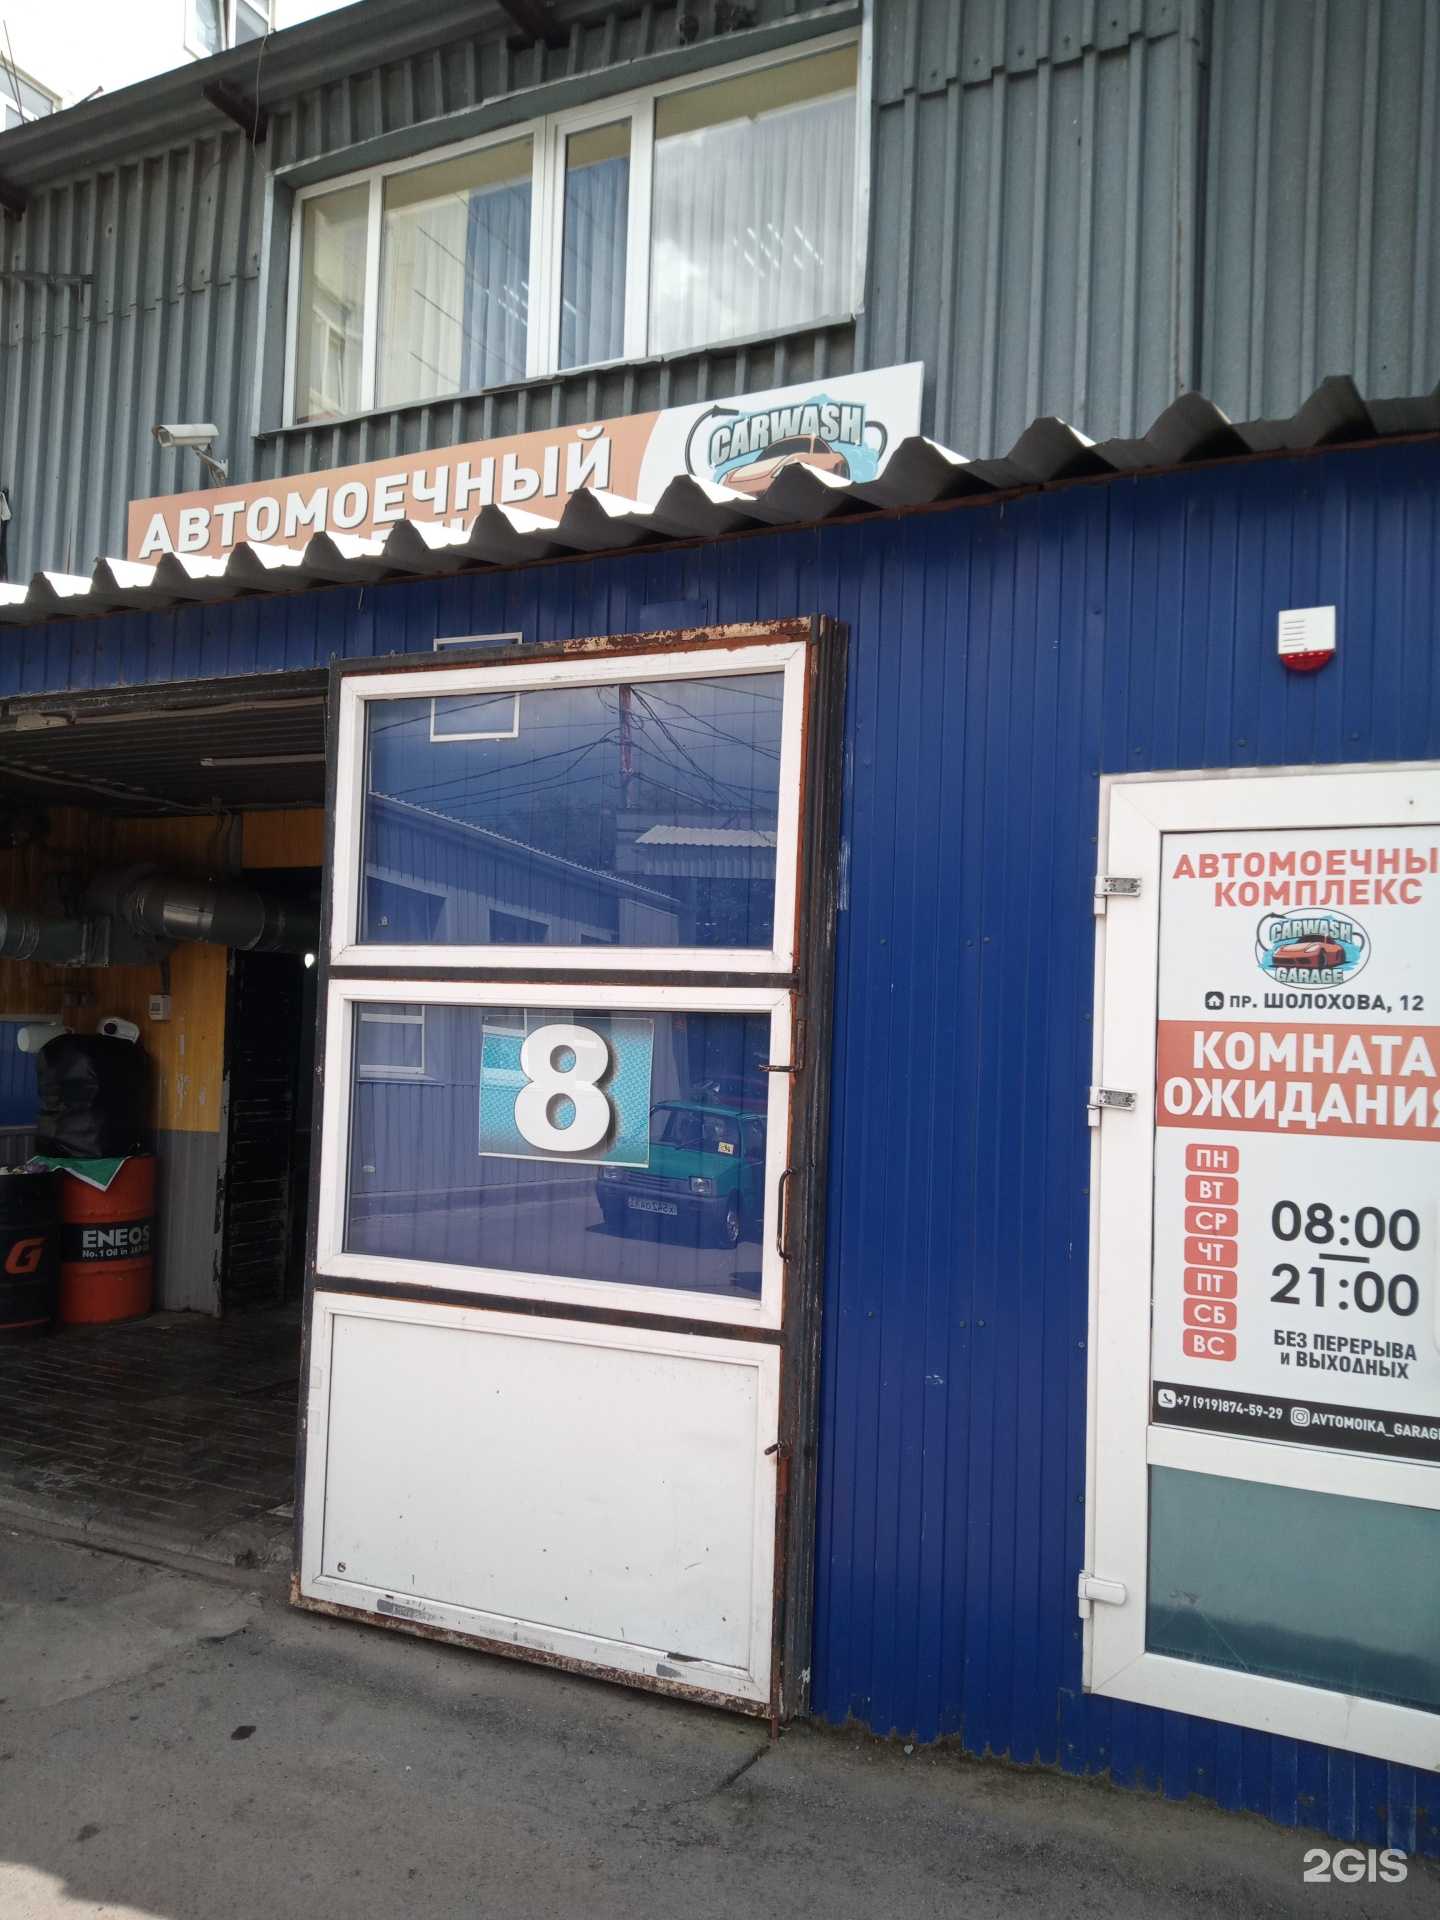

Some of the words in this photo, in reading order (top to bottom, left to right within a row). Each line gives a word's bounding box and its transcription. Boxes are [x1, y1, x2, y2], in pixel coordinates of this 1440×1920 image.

[709, 403, 863, 466] CARWASH
[138, 425, 613, 558] АВТОМОЕЧНЫЙ
[1172, 847, 1440, 879] АВТОМОЕЧНЫ
[1214, 878, 1424, 908] КОМПЛЕКС
[1269, 918, 1353, 943] CARWASH
[1275, 967, 1344, 985] GARAGE
[1264, 993, 1393, 1013] ШОЛОХОВА,
[1400, 994, 1425, 1011] 12
[1193, 1030, 1438, 1078] КОМНАТА
[514, 1024, 611, 1152] 8
[1163, 1076, 1440, 1130] ОЖИДАНИ
[1196, 1149, 1229, 1169] ПН
[1199, 1180, 1224, 1200] ВТ
[1195, 1211, 1228, 1231] СР
[1271, 1200, 1421, 1252] 08:00
[82, 1225, 150, 1248] ENEOS
[1198, 1242, 1224, 1263] ЧТ
[1197, 1273, 1224, 1294] ПТ
[1270, 1263, 1420, 1317] 21:00
[1193, 1304, 1227, 1325] СБ
[1193, 1334, 1225, 1356] ВС
[1273, 1329, 1308, 1349] БЕЗ
[1313, 1334, 1417, 1362] ПЕРЕРЫВА
[1296, 1350, 1409, 1380] ВЫХОДНЫХ
[1176, 1395, 1191, 1407] +7
[1311, 1412, 1440, 1441] AVTOMOIKA_GARAG
